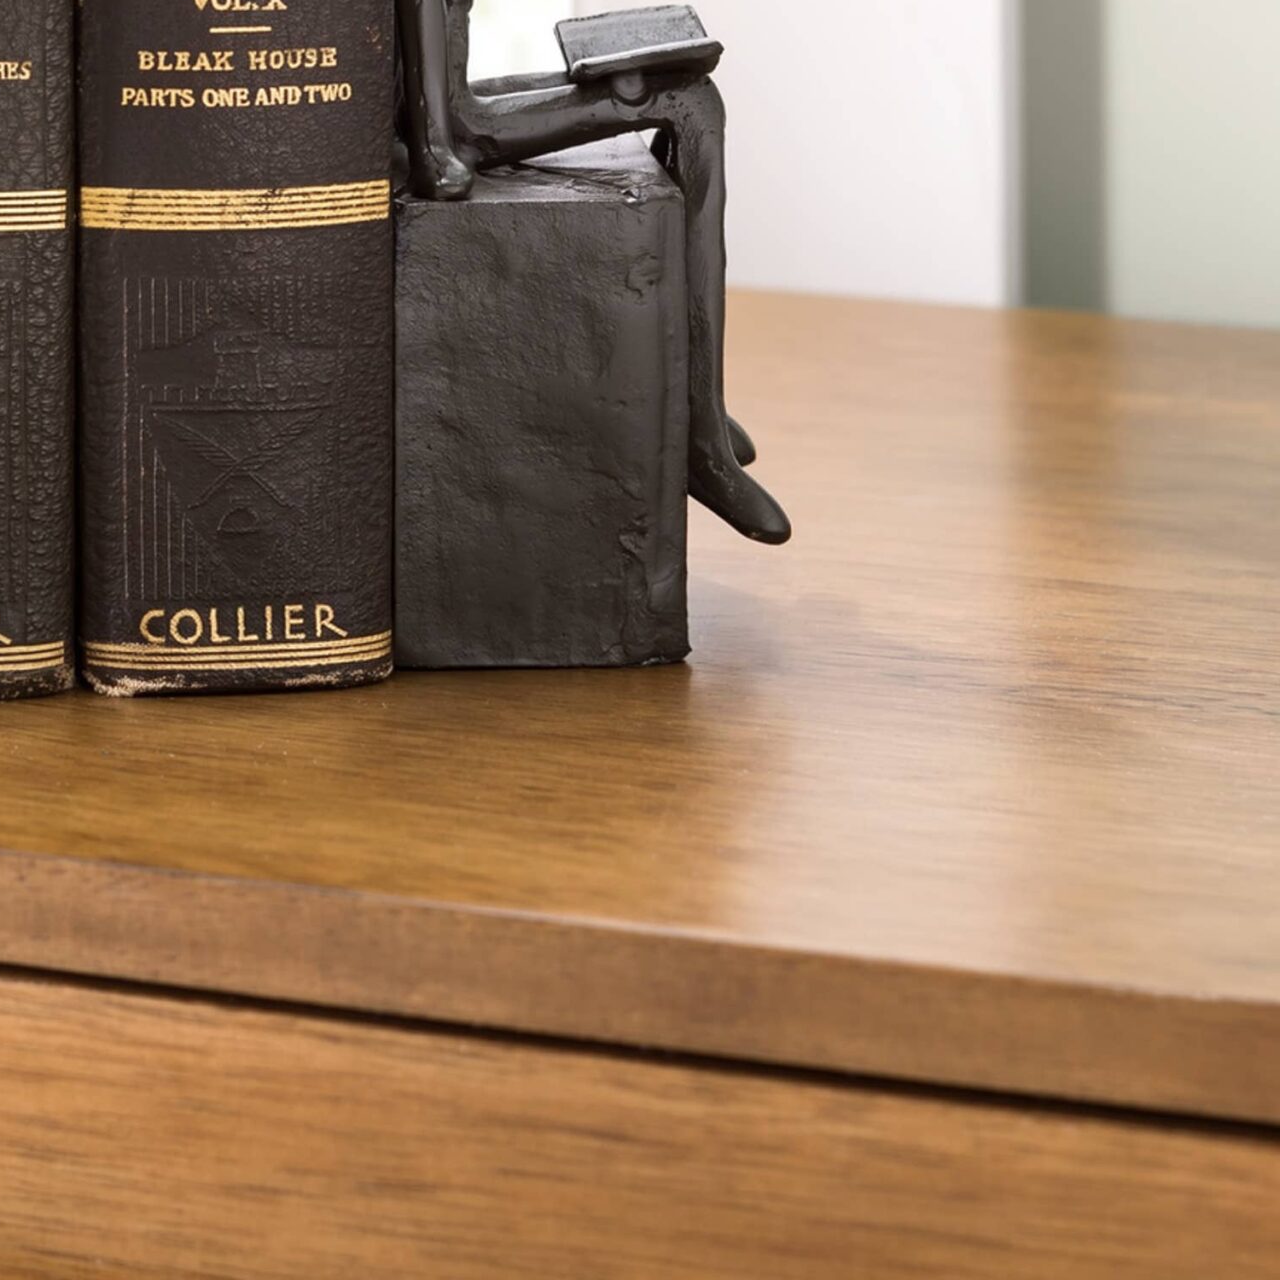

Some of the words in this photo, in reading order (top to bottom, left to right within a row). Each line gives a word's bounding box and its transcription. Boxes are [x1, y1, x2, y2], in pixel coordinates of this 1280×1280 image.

[137, 50, 235, 72] BLEAK
[247, 46, 338, 71] HOUSE
[120, 87, 196, 108] PARTS
[201, 87, 251, 108] ONE
[254, 85, 303, 107] AND
[302, 82, 352, 105] TWO
[139, 603, 348, 646] COLLIER
